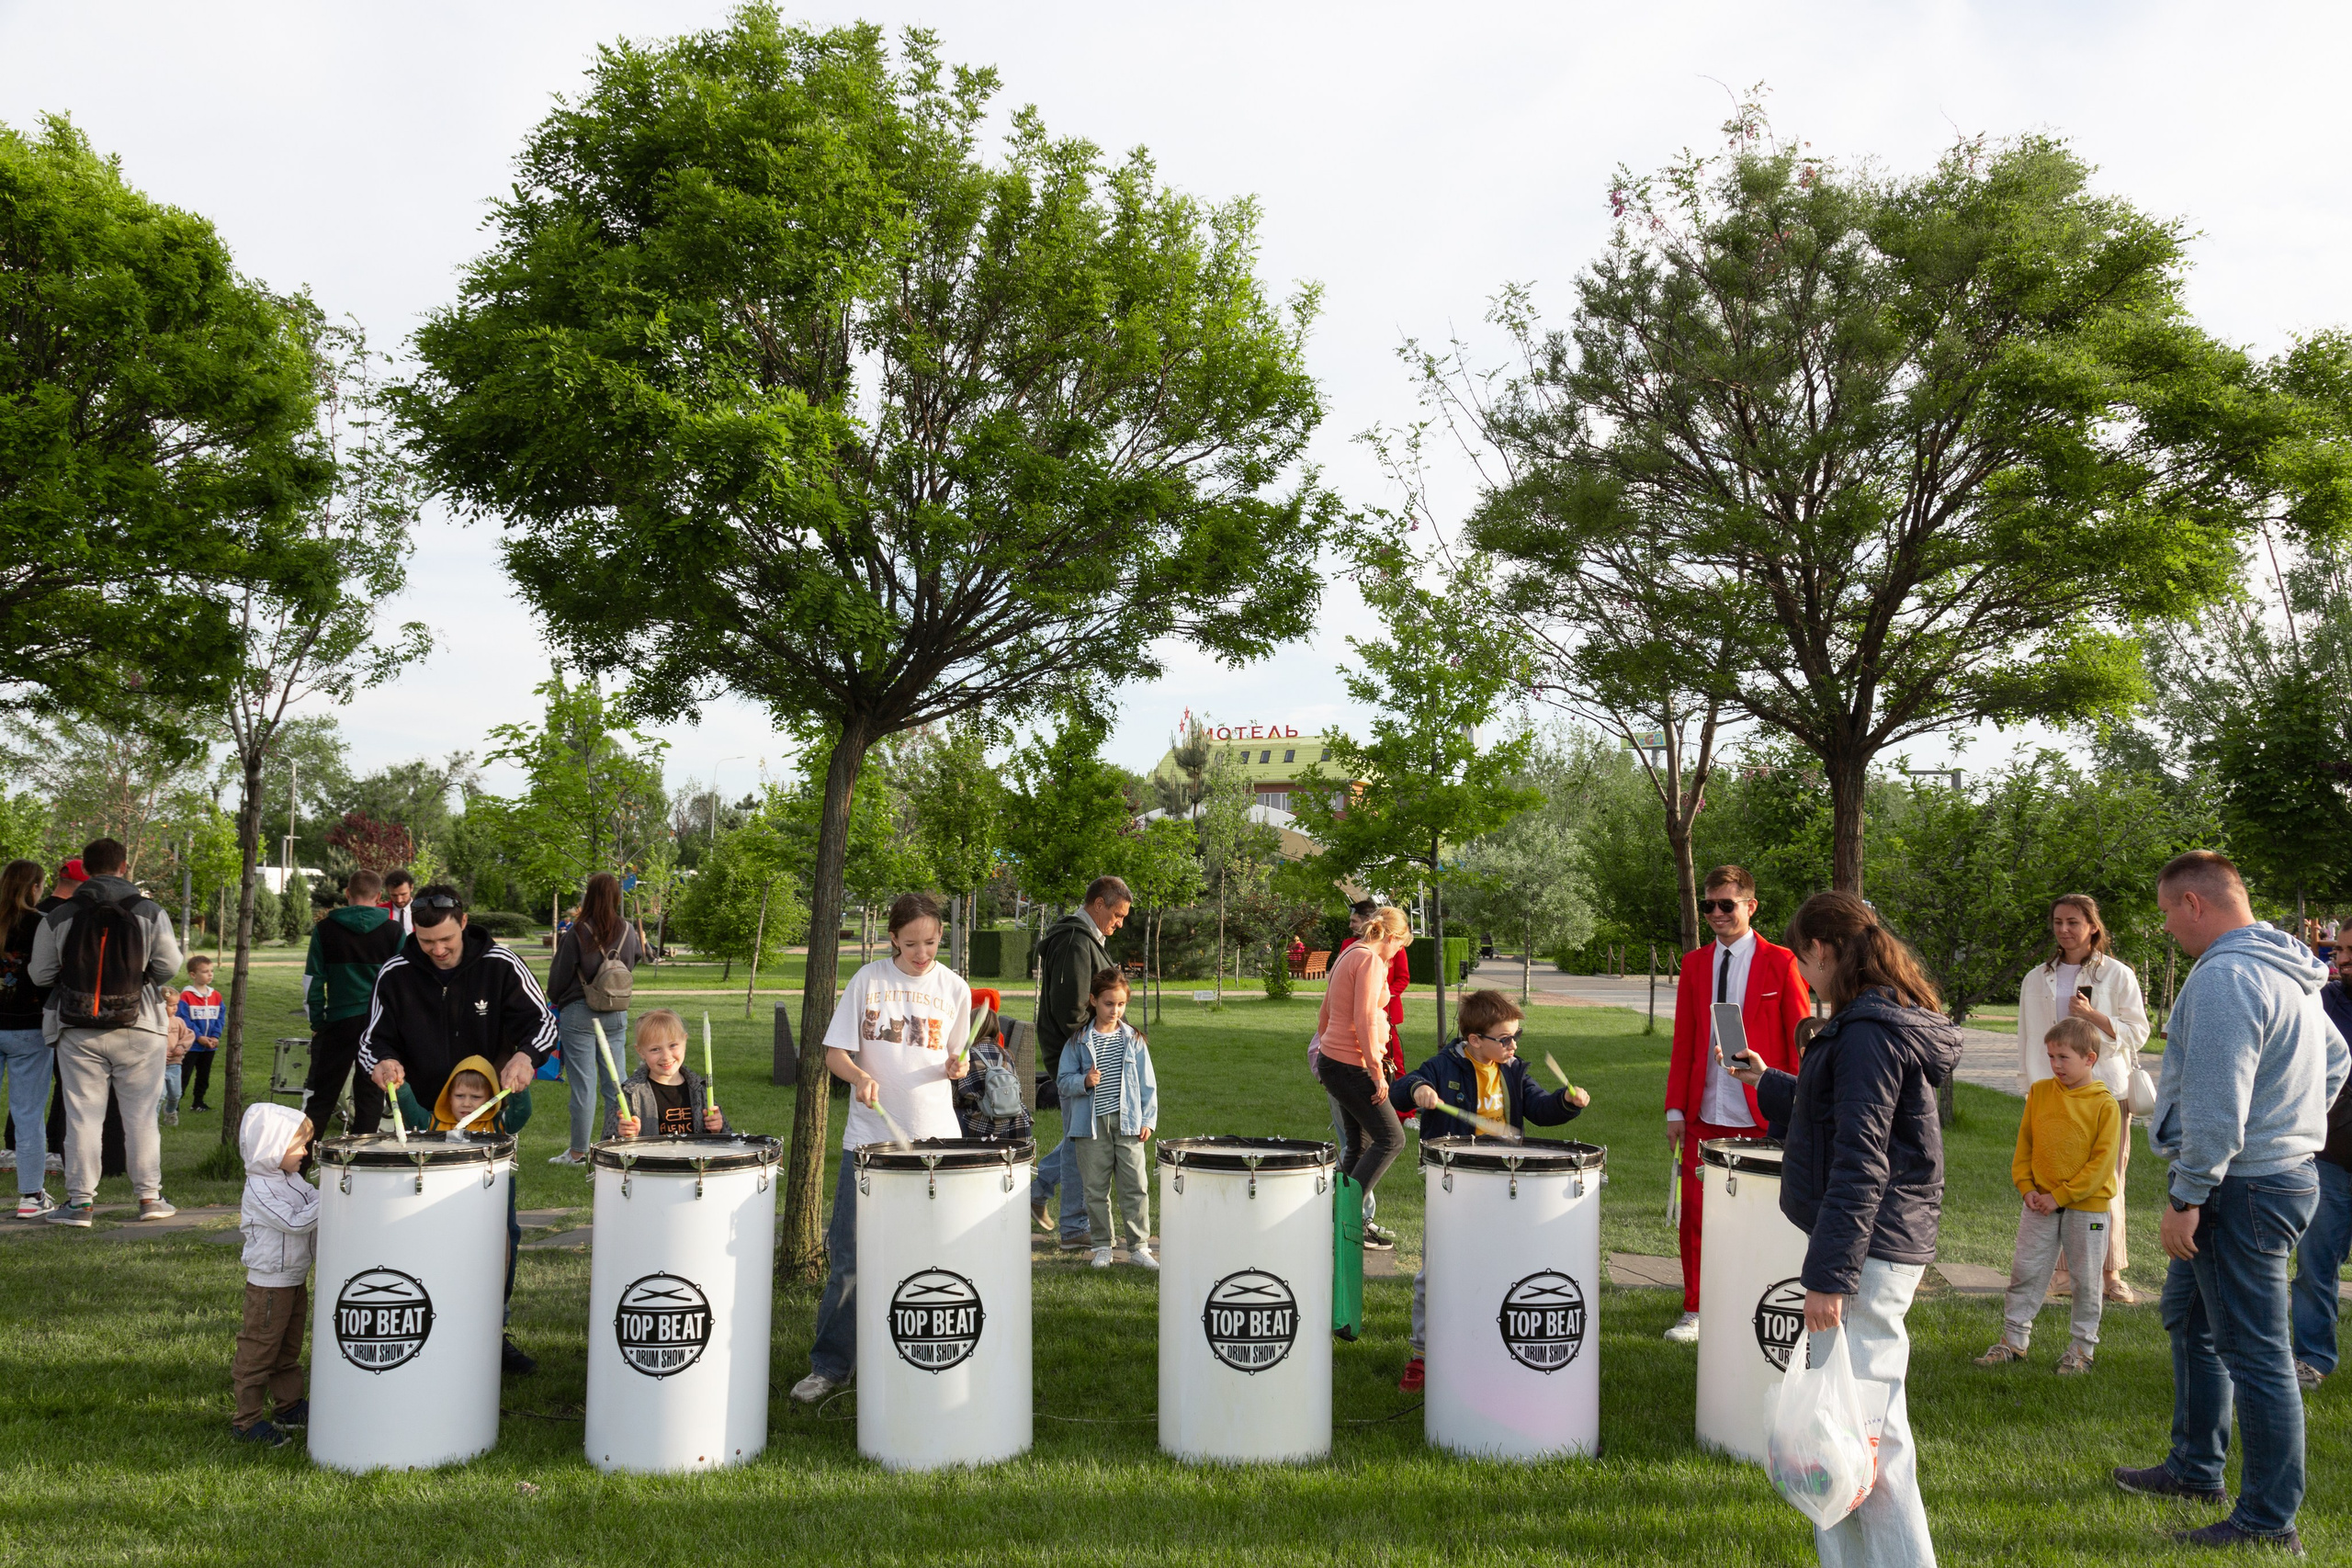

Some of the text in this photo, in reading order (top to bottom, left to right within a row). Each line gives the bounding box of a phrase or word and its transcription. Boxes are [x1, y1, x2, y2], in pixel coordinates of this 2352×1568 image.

[865, 991, 881, 1005] HE
[884, 990, 931, 1005] KITTIES
[340, 1307, 426, 1336] TOP BEAT
[621, 1313, 706, 1341] TOP BEAT
[895, 1307, 977, 1336] TOP BEAT
[1210, 1309, 1293, 1337] TOP BEAT
[1507, 1308, 1582, 1337] TOP BEAT
[1761, 1312, 1799, 1342] TOP
[354, 1343, 405, 1362] DRUM SHOW
[636, 1349, 685, 1368] DRUM SHOW
[911, 1343, 960, 1362] DRUM SHOW
[1227, 1345, 1276, 1363] DRUM SHOW
[1524, 1344, 1569, 1363] DRUM SHOW
